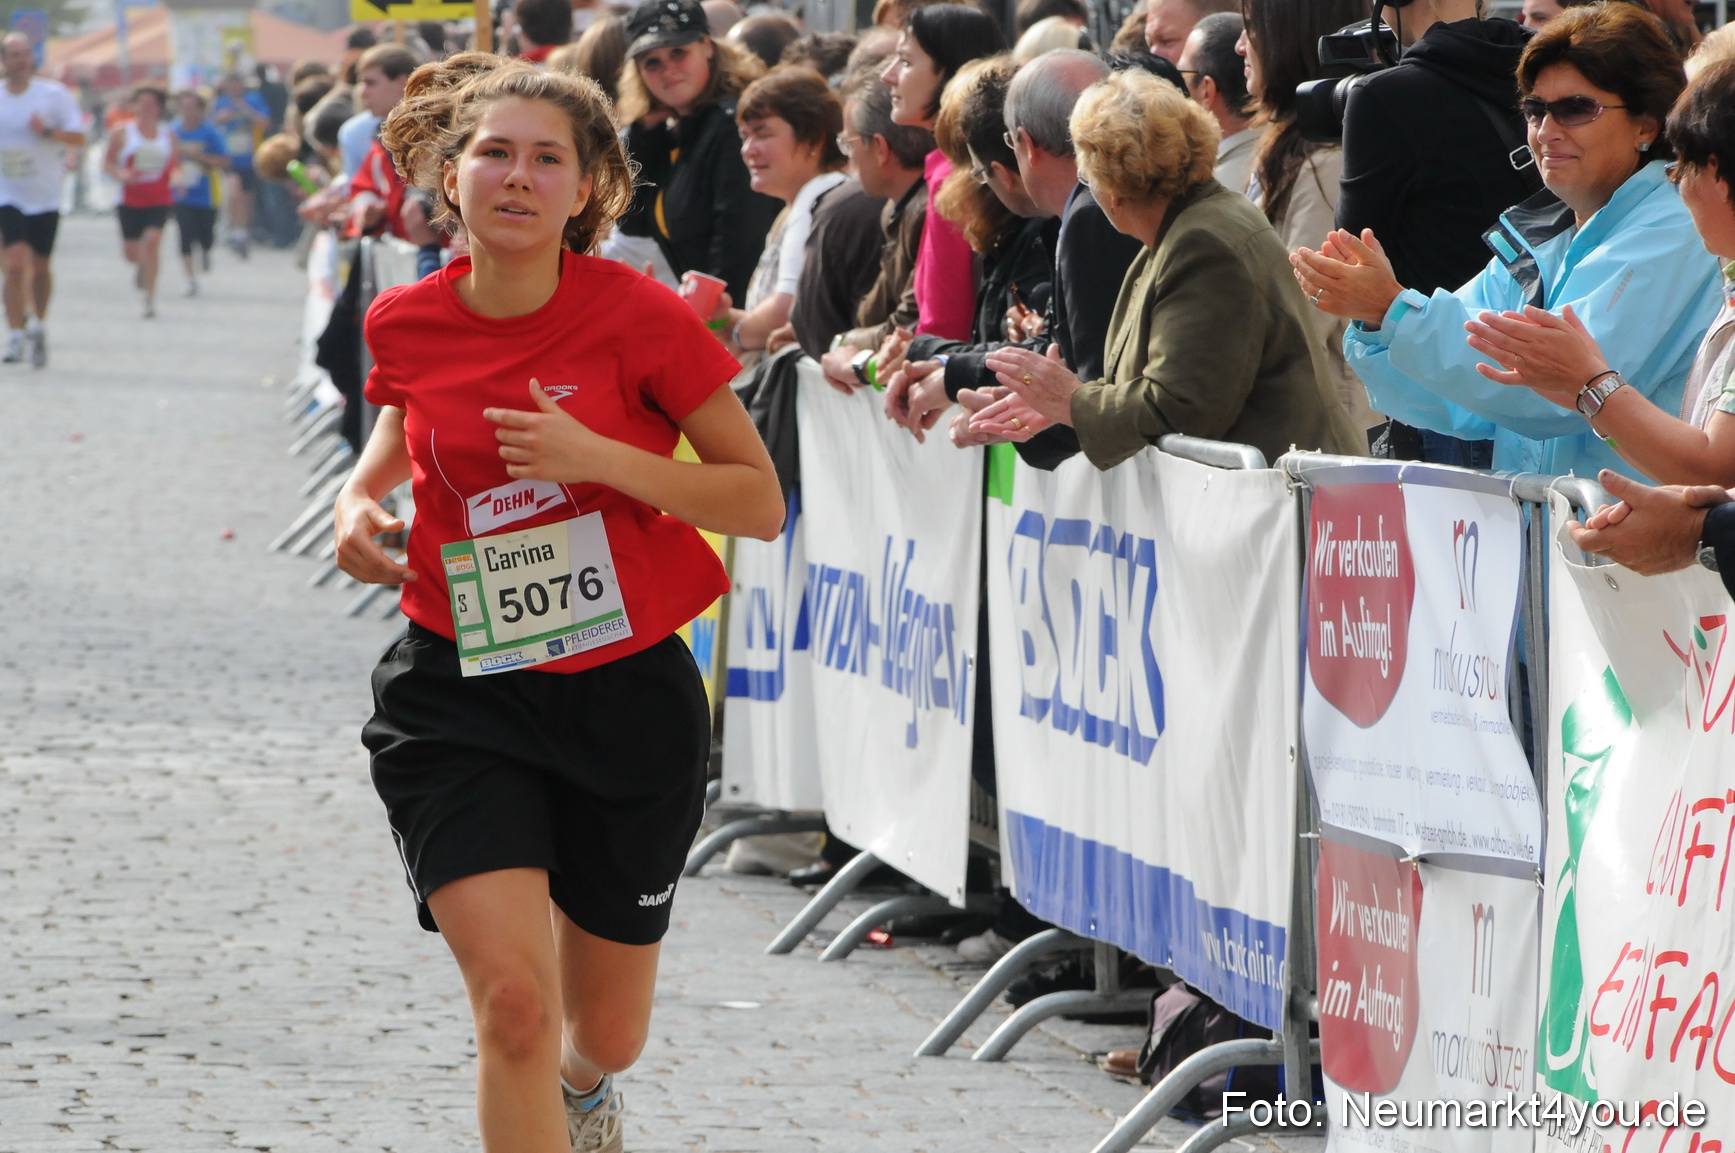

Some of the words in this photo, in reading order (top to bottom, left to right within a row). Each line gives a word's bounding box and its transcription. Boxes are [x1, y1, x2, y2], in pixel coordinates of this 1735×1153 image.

[493, 488, 535, 516] DEHN
[484, 544, 555, 572] Carina
[1314, 520, 1336, 577] Wir
[1339, 514, 1399, 578] verkaufen
[458, 593, 467, 613] S
[499, 566, 604, 623] 5076
[565, 618, 626, 645] PFLEIDERER
[1008, 509, 1165, 767] BOCK
[1319, 602, 1338, 657] im
[1342, 596, 1393, 679] Auftrag!
[480, 651, 523, 669] BOCK
[638, 890, 669, 906] JAKO
[1330, 877, 1355, 937] Wir
[1322, 960, 1352, 1019] im
[1354, 964, 1404, 1052] Auftrag!
